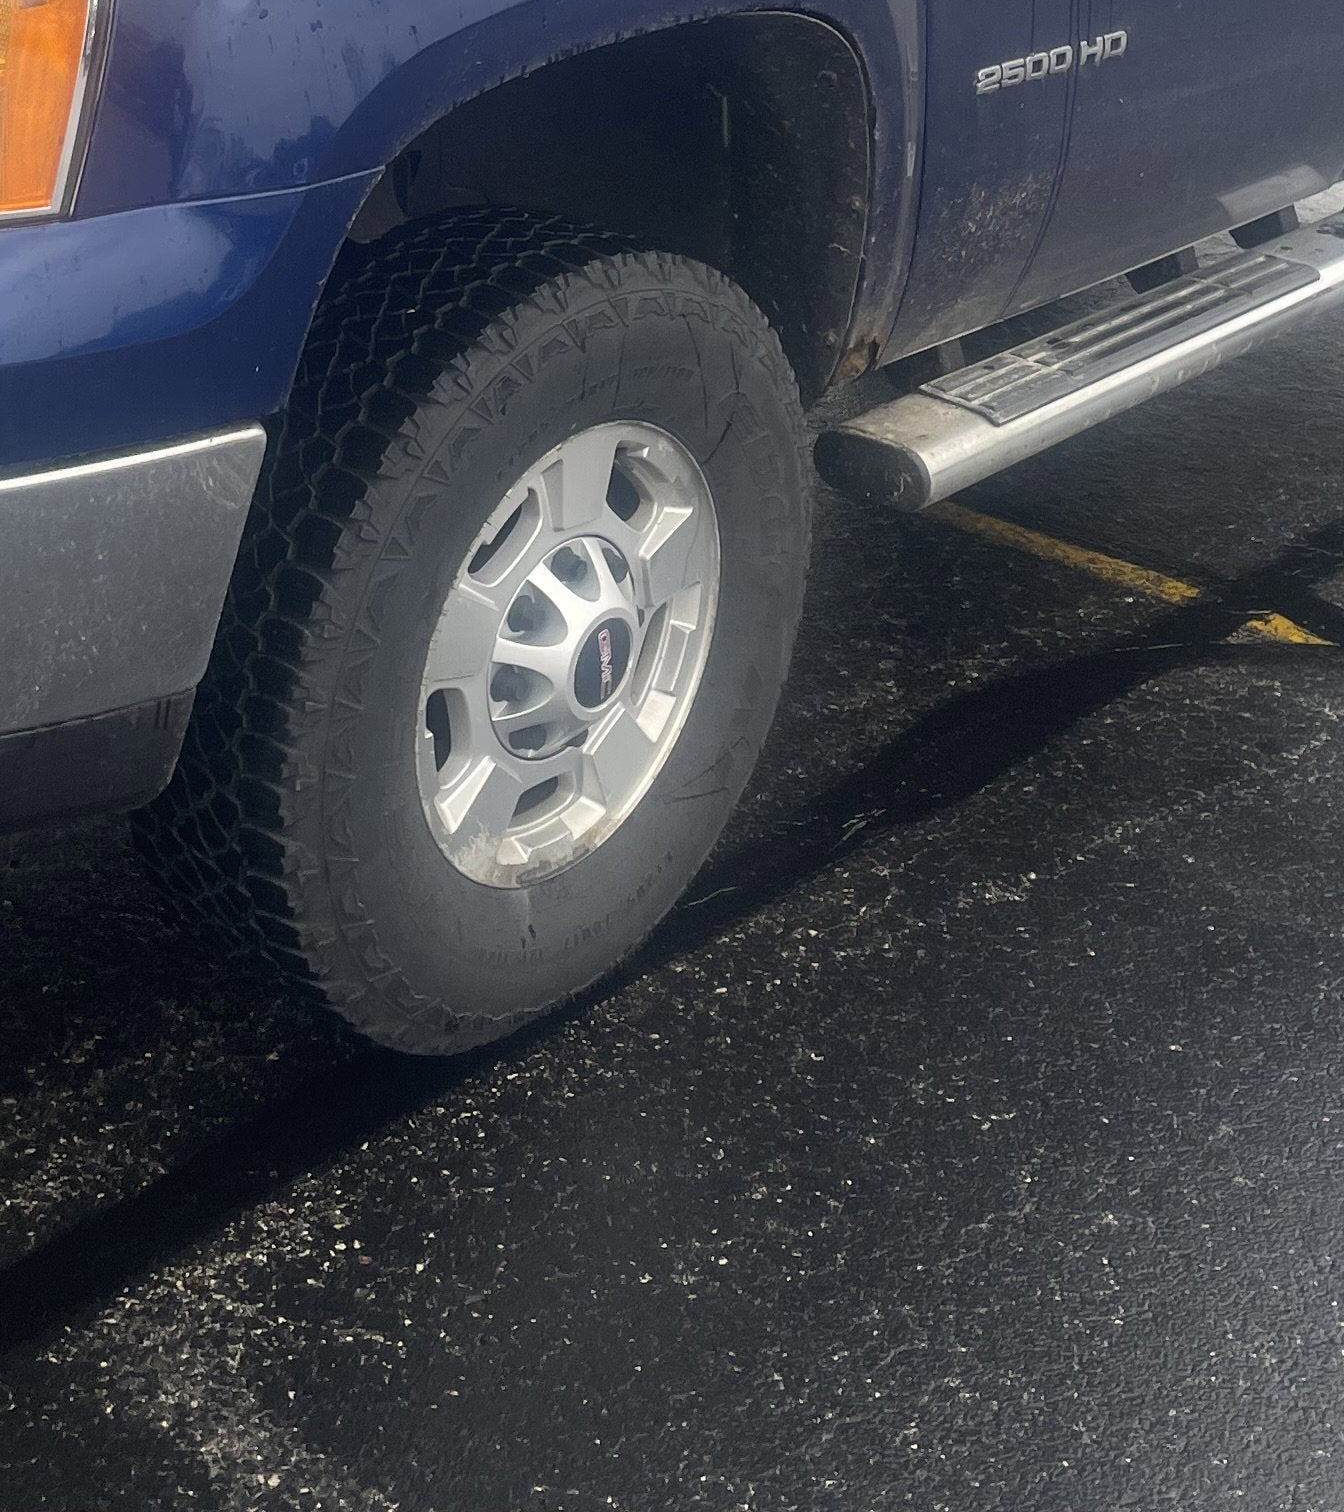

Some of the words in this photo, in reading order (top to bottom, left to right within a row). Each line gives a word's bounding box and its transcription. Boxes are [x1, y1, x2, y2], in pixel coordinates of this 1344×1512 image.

[975, 45, 1073, 95] 2500
[1080, 30, 1128, 66] HD
[598, 628, 613, 700] GMC
